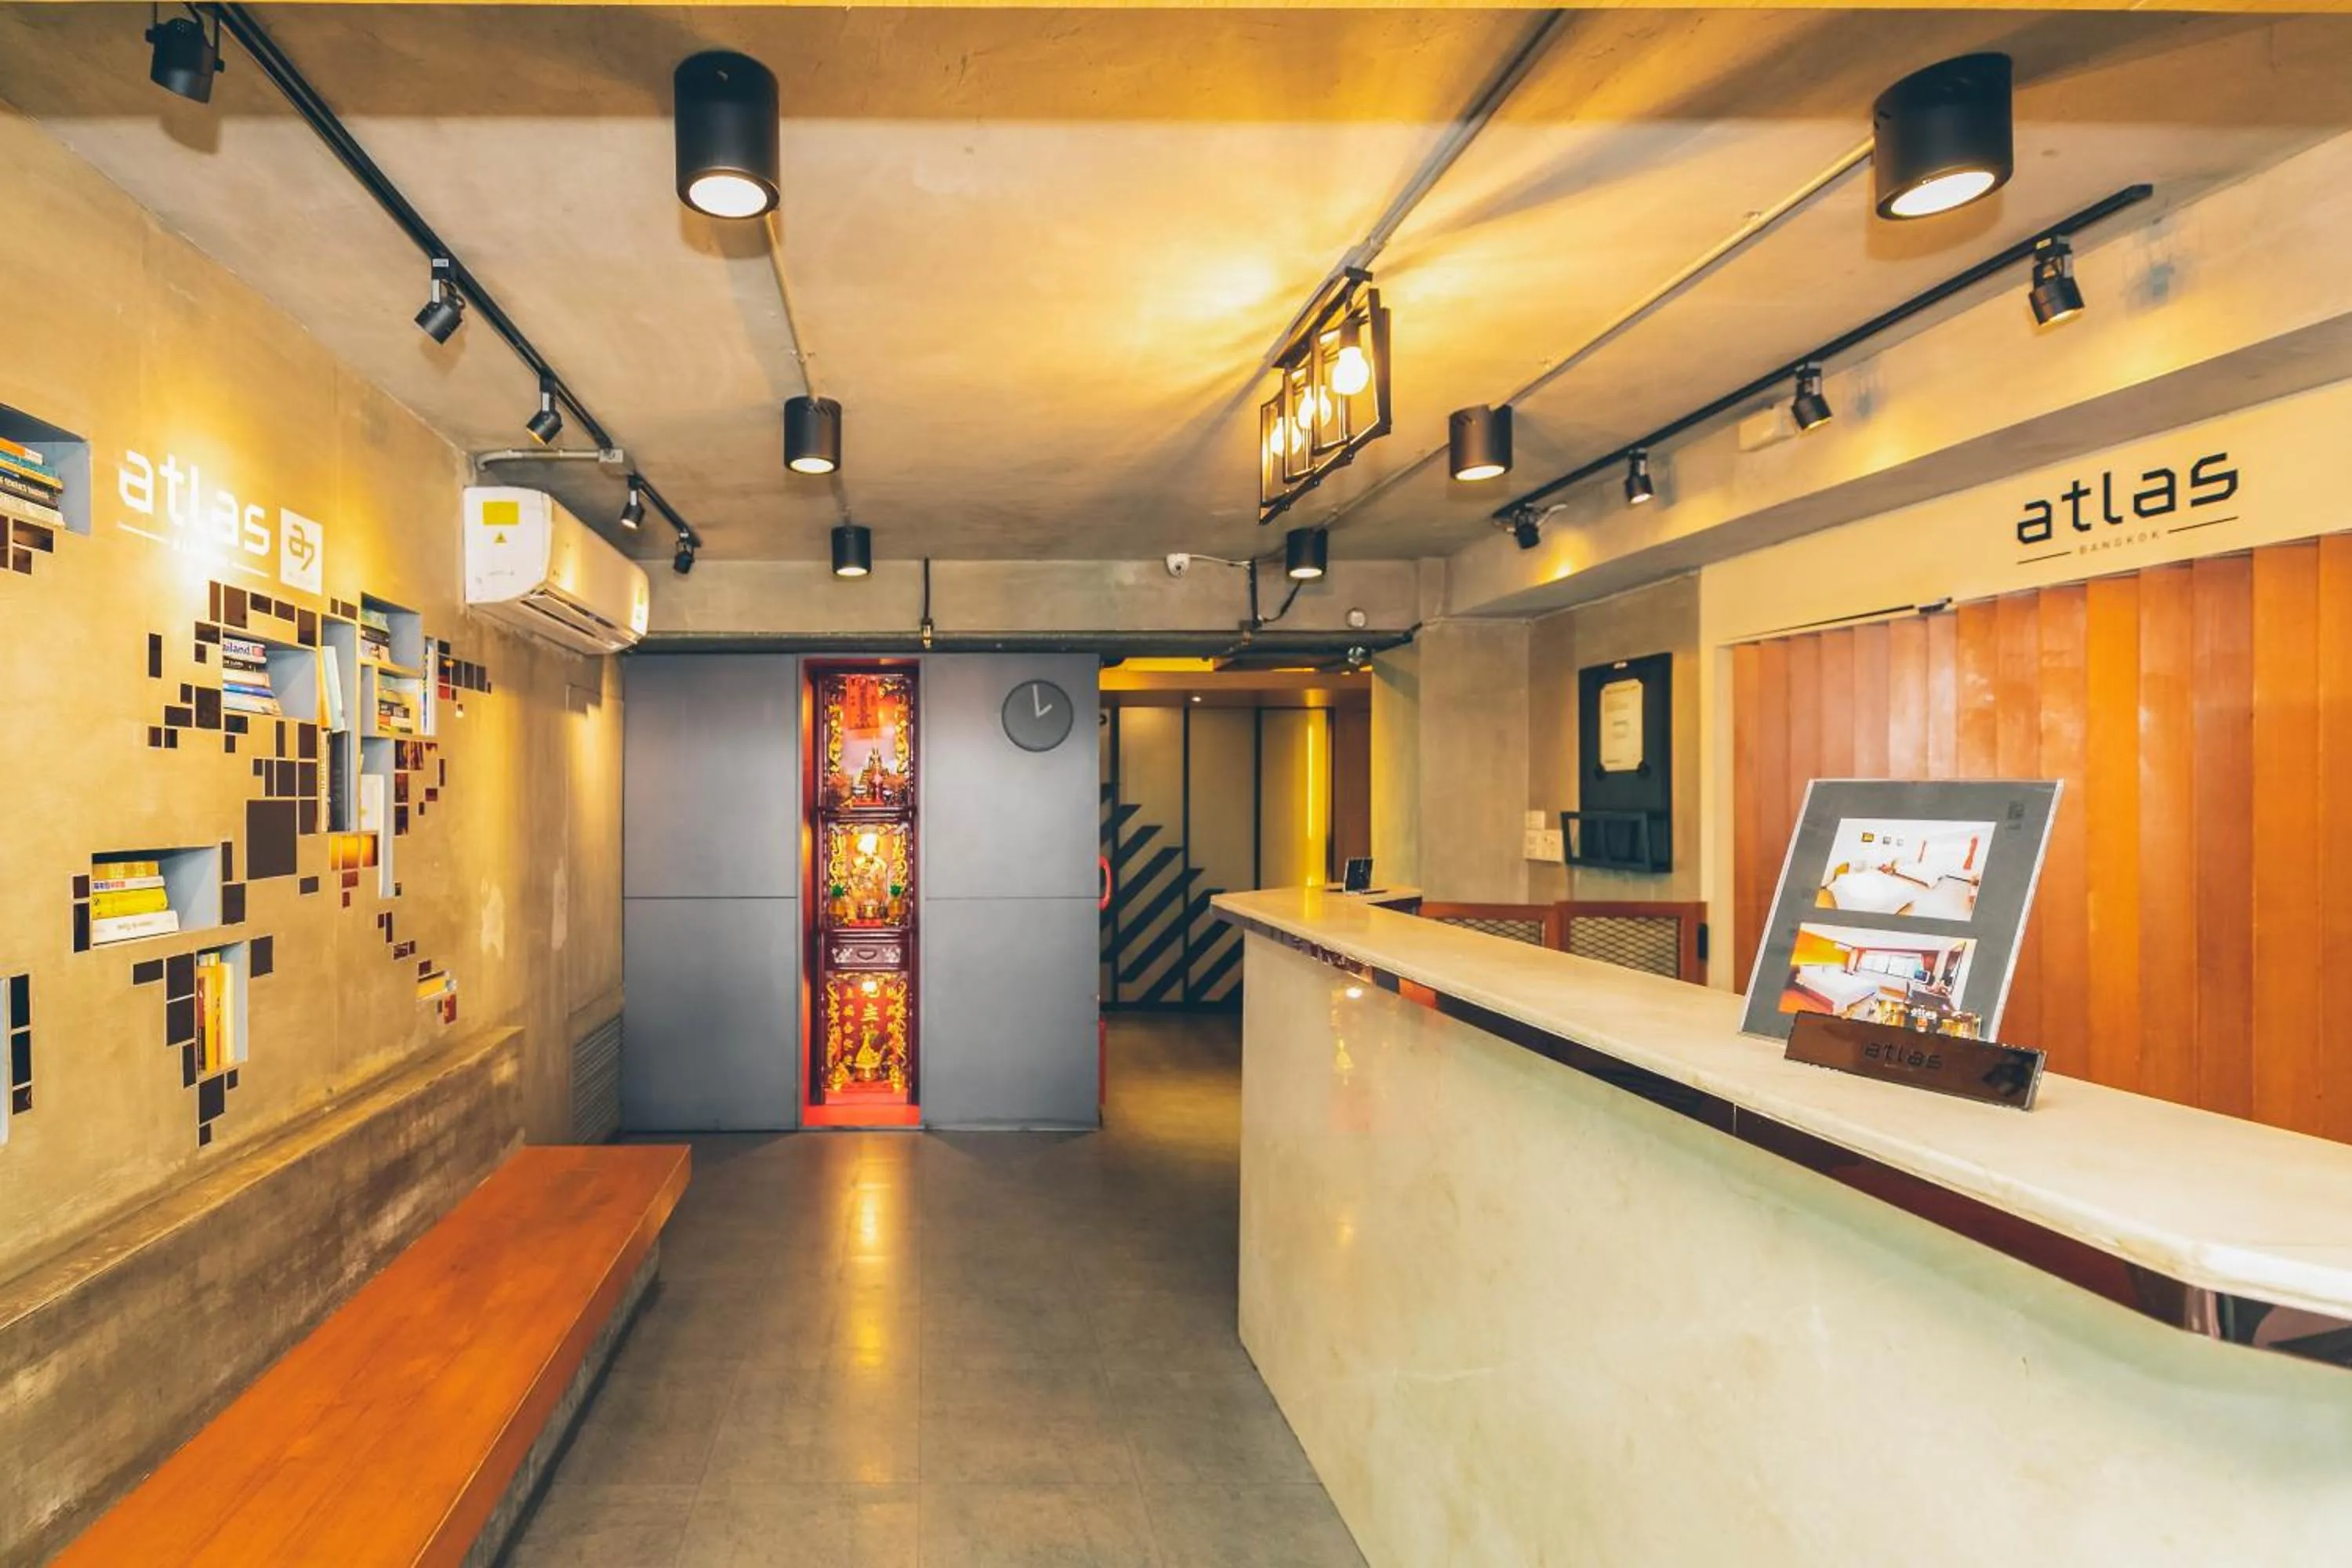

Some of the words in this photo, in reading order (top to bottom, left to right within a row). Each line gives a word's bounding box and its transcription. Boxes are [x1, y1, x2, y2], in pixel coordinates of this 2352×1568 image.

[118, 449, 270, 556] atlas
[2017, 452, 2238, 544] atlas
[2079, 530, 2160, 554] BANGKOK
[1865, 1041, 1941, 1069] atlas
